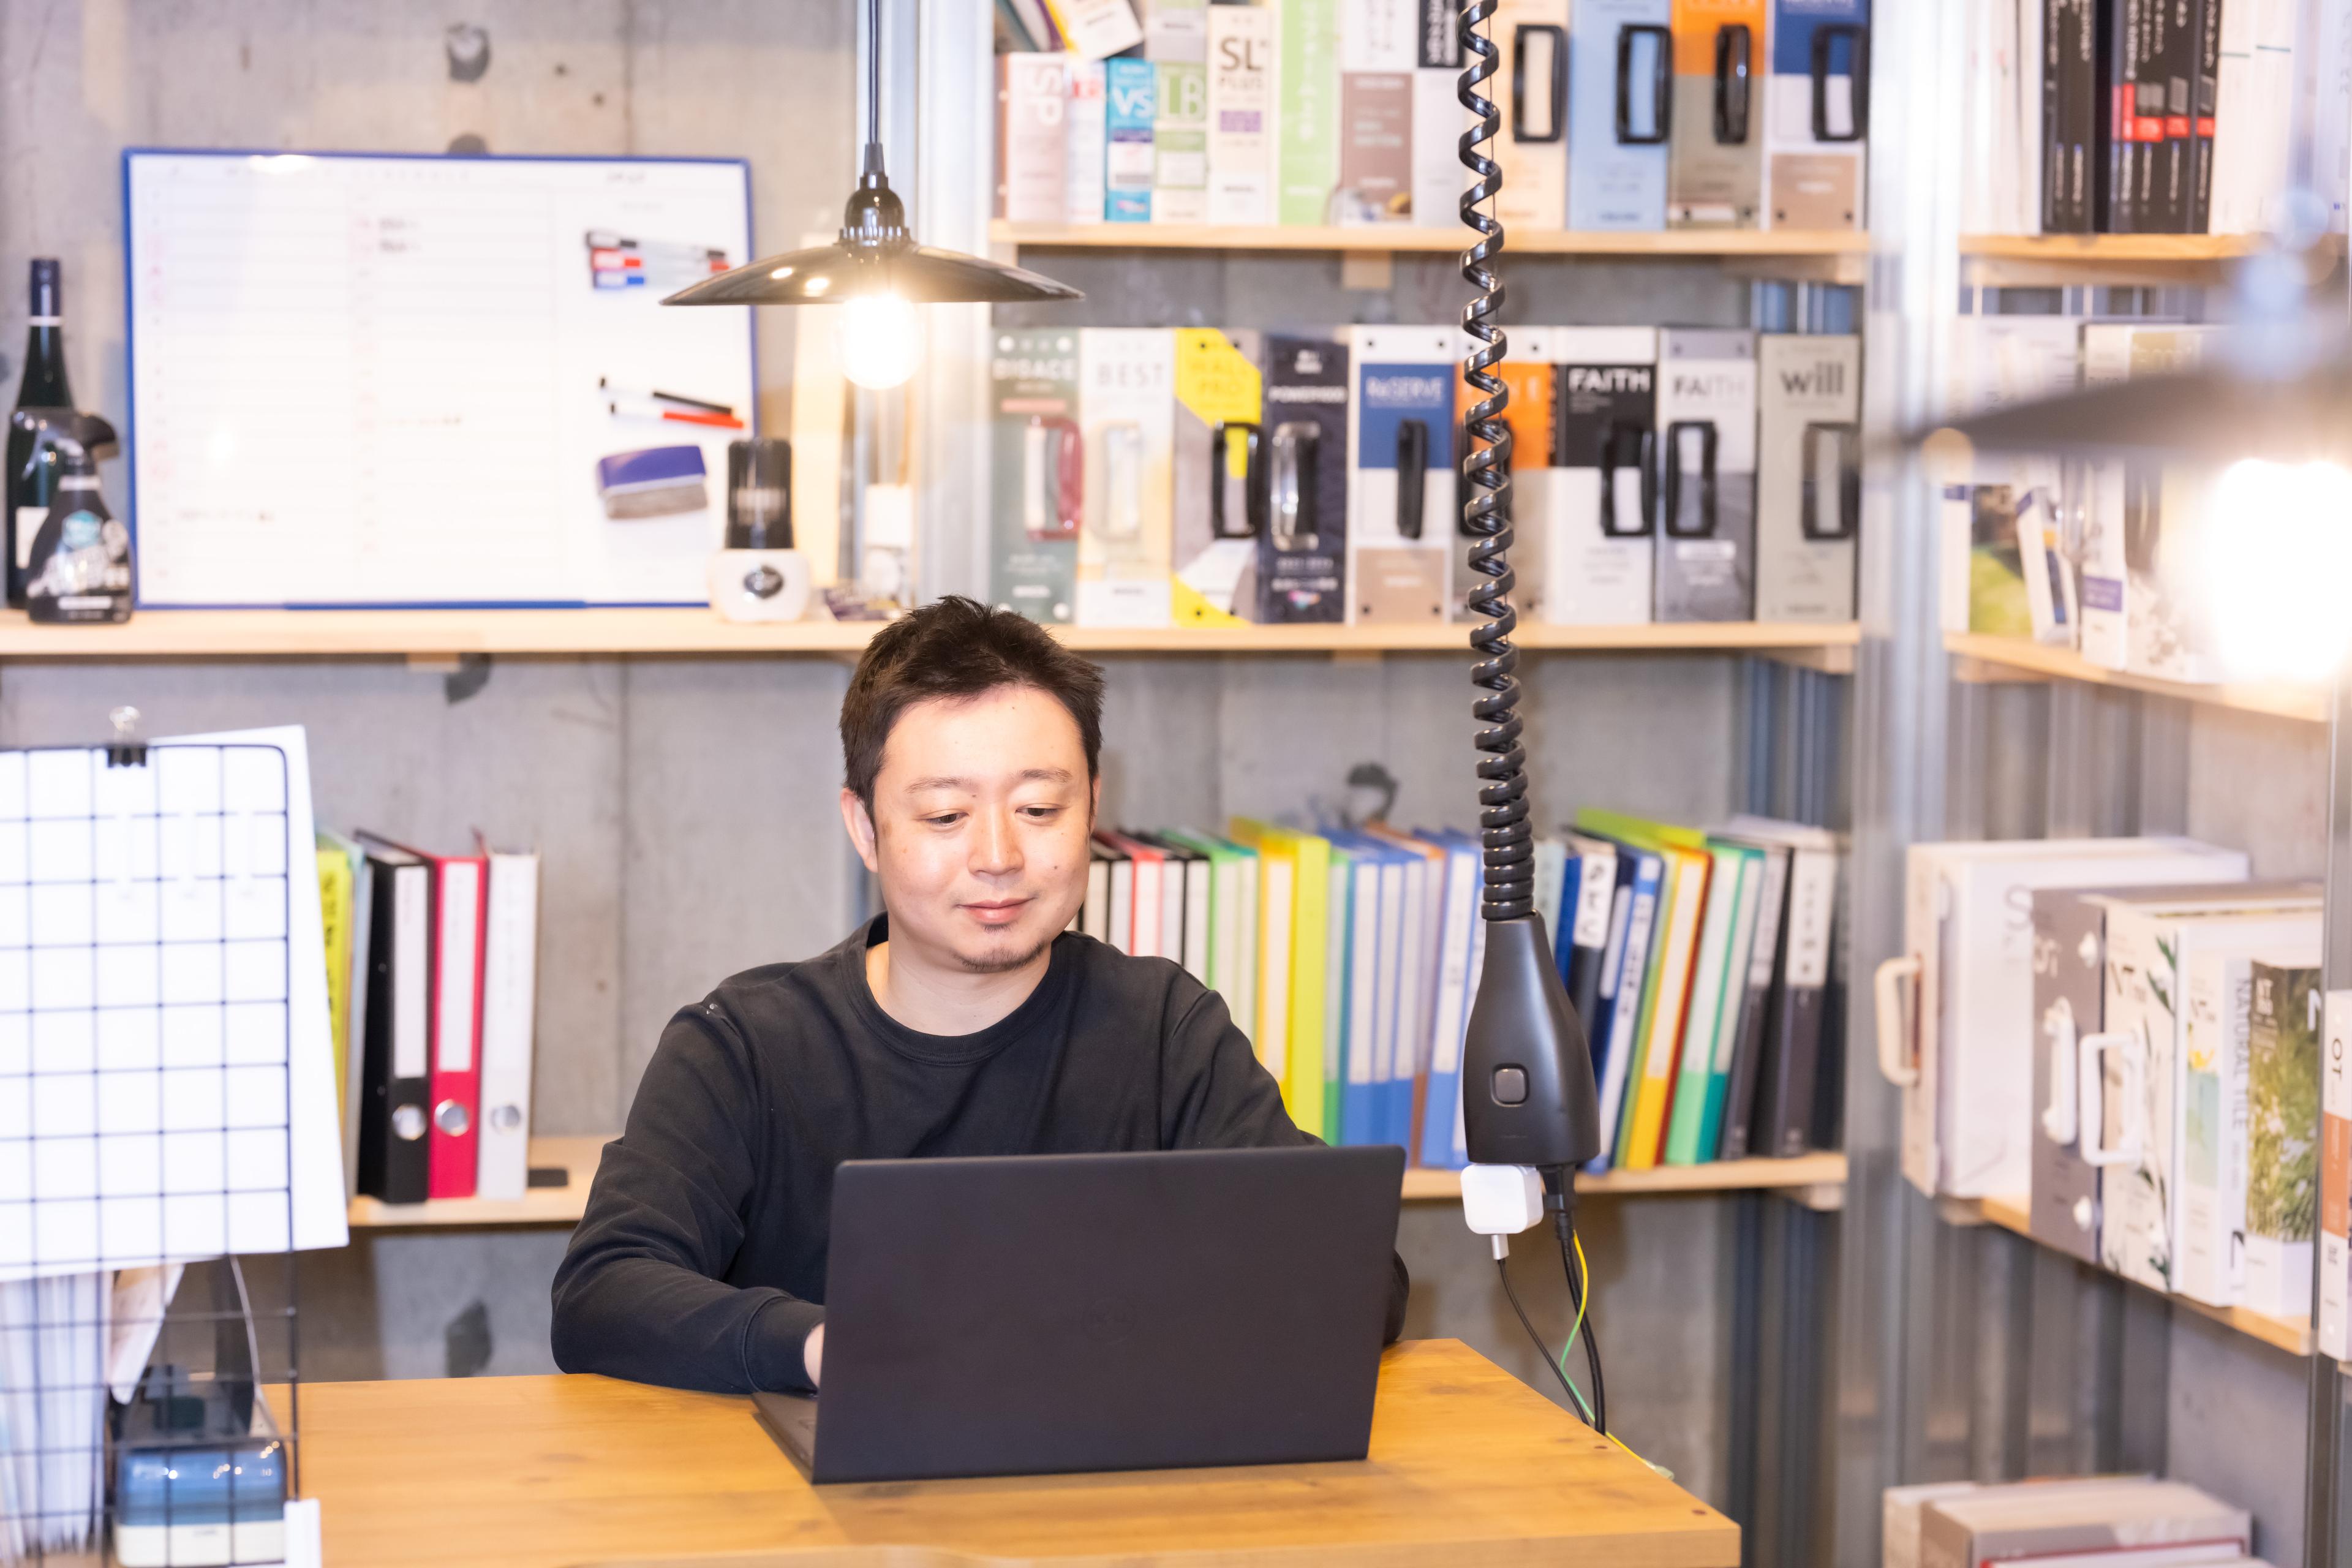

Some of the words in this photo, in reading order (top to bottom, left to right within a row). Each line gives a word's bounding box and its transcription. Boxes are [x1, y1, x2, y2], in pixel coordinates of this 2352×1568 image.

[1112, 86, 1156, 118] VS
[1098, 361, 1164, 387] BEST
[1568, 368, 1651, 392] FAITH
[1673, 374, 1746, 398] FAITH
[1779, 360, 1844, 395] will
